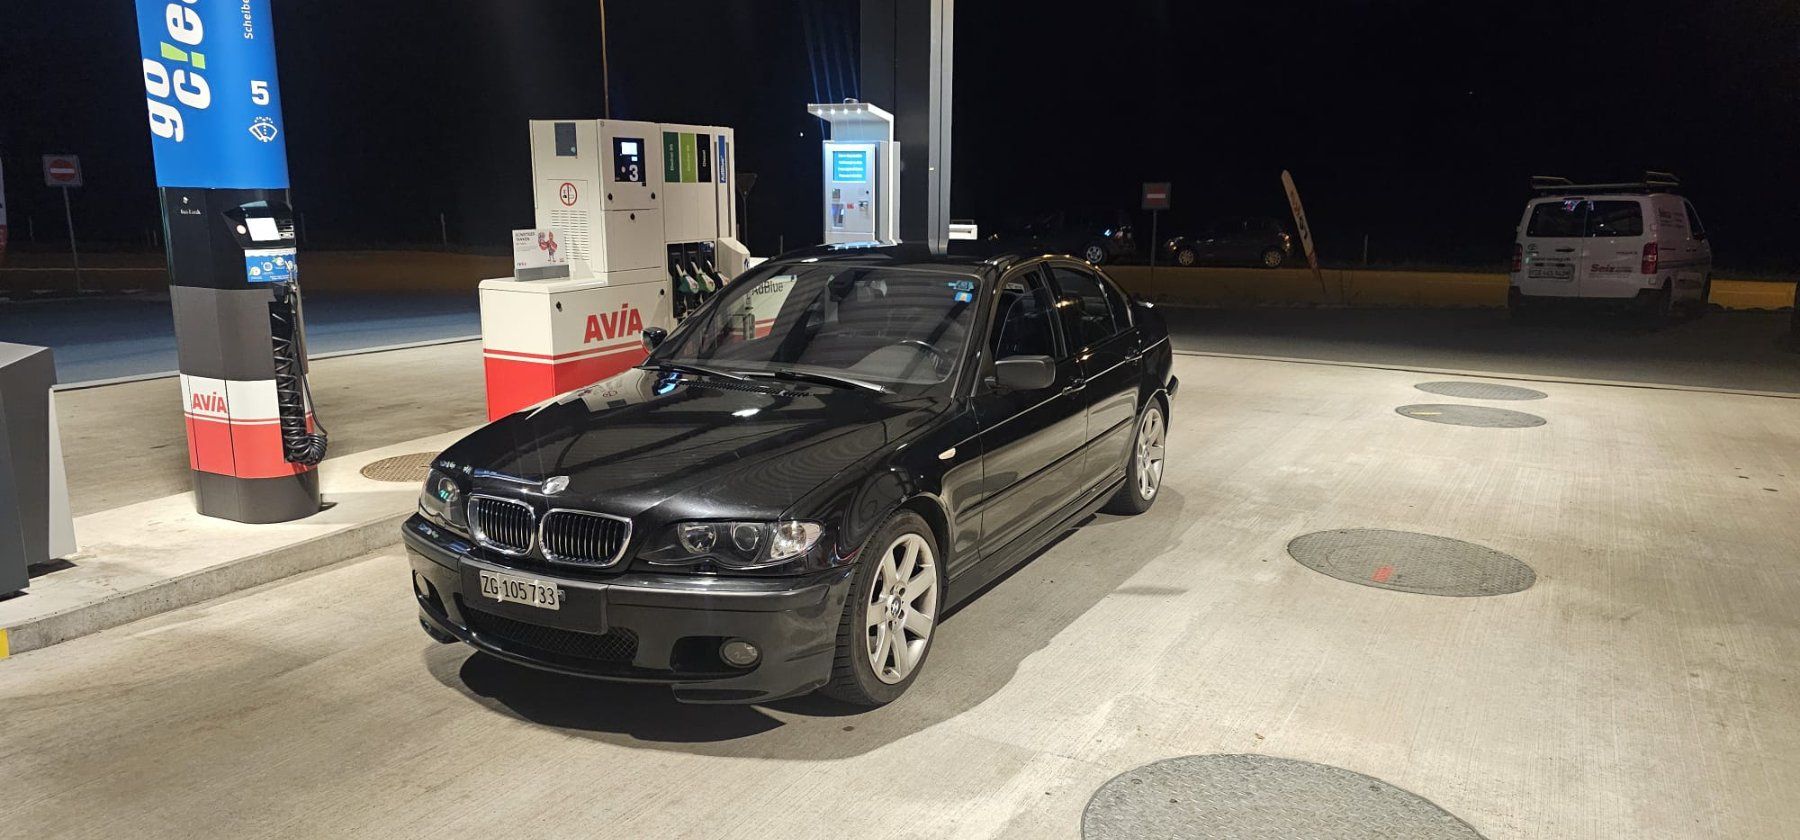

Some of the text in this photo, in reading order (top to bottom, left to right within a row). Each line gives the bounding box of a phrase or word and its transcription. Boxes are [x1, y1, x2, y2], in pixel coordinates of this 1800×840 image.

[250, 80, 270, 106] 5
[629, 164, 639, 182] 3
[583, 303, 644, 344] AVIA
[192, 391, 227, 414] AVIA
[481, 575, 499, 595] ZG
